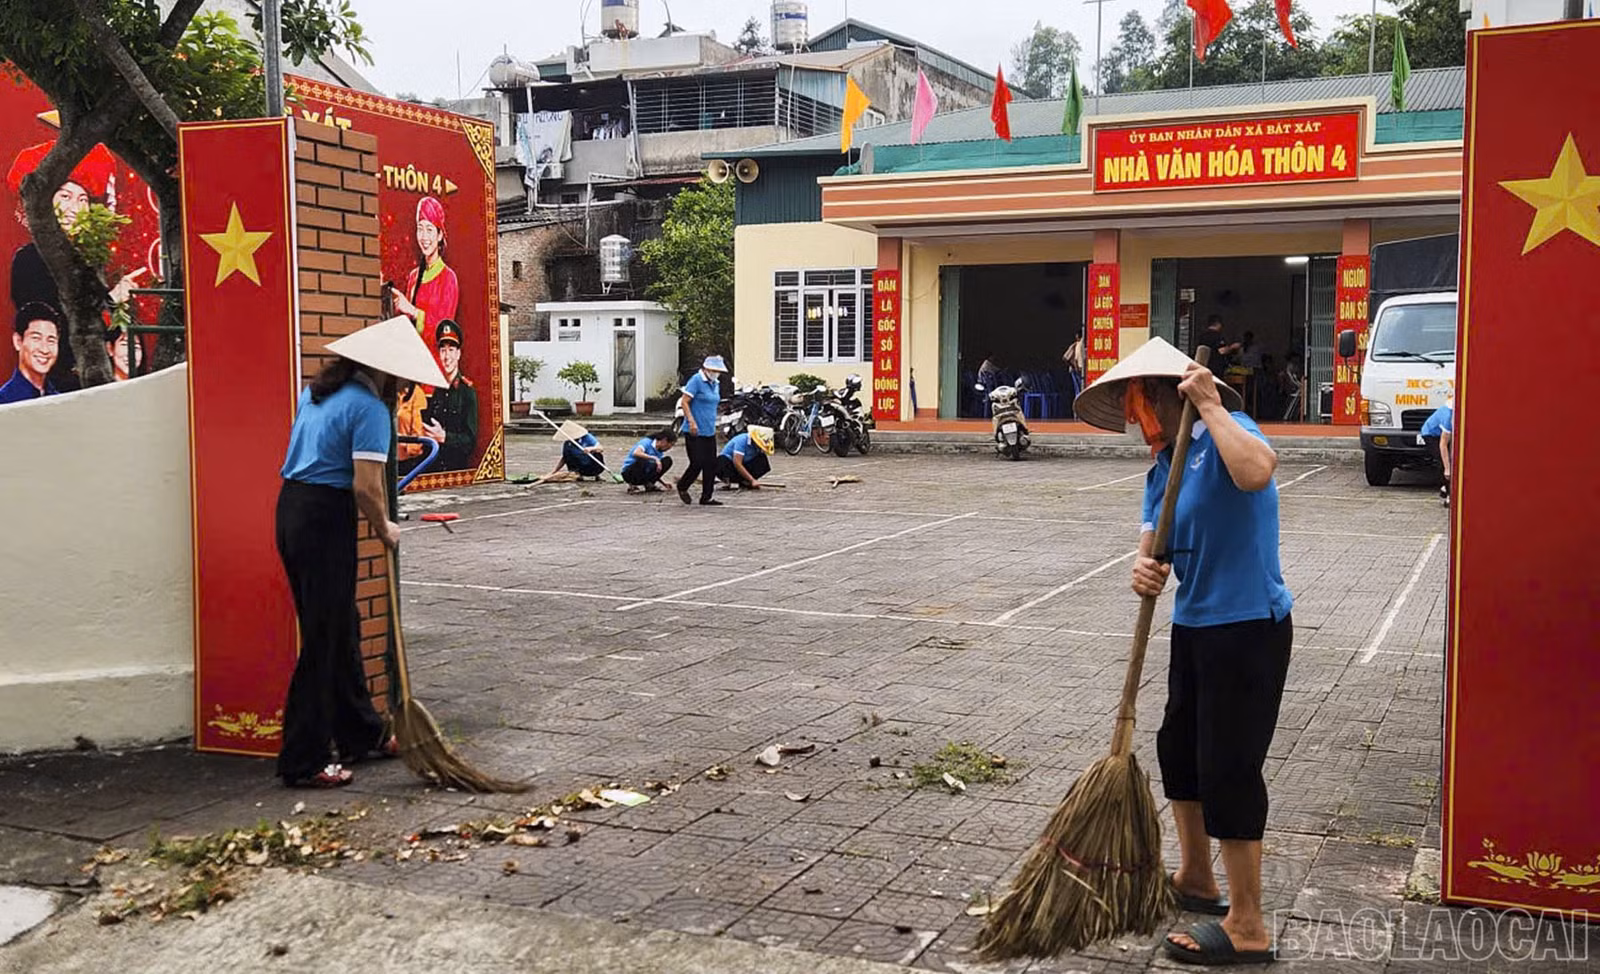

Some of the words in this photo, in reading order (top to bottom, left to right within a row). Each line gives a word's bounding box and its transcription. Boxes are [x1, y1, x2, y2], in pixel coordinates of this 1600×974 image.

[1129, 130, 1146, 144] ỦY
[1149, 131, 1174, 143] BAN
[1177, 127, 1212, 140] NHÂN
[1215, 125, 1242, 138] DÂN
[1245, 124, 1263, 137] XÃ
[1266, 122, 1290, 135] BÁT
[1294, 121, 1321, 134] XÁT
[1103, 147, 1150, 183] NHÀ
[1156, 147, 1202, 181] VĂN
[1208, 144, 1255, 178] HÓA
[1262, 141, 1325, 175] THÔN
[1330, 144, 1347, 171] 4
[383, 164, 429, 193] THÔN
[432, 174, 443, 195] 4
[877, 316, 896, 331] GỐC
[875, 376, 898, 393] ĐỘNG
[1395, 393, 1429, 405] MINH
